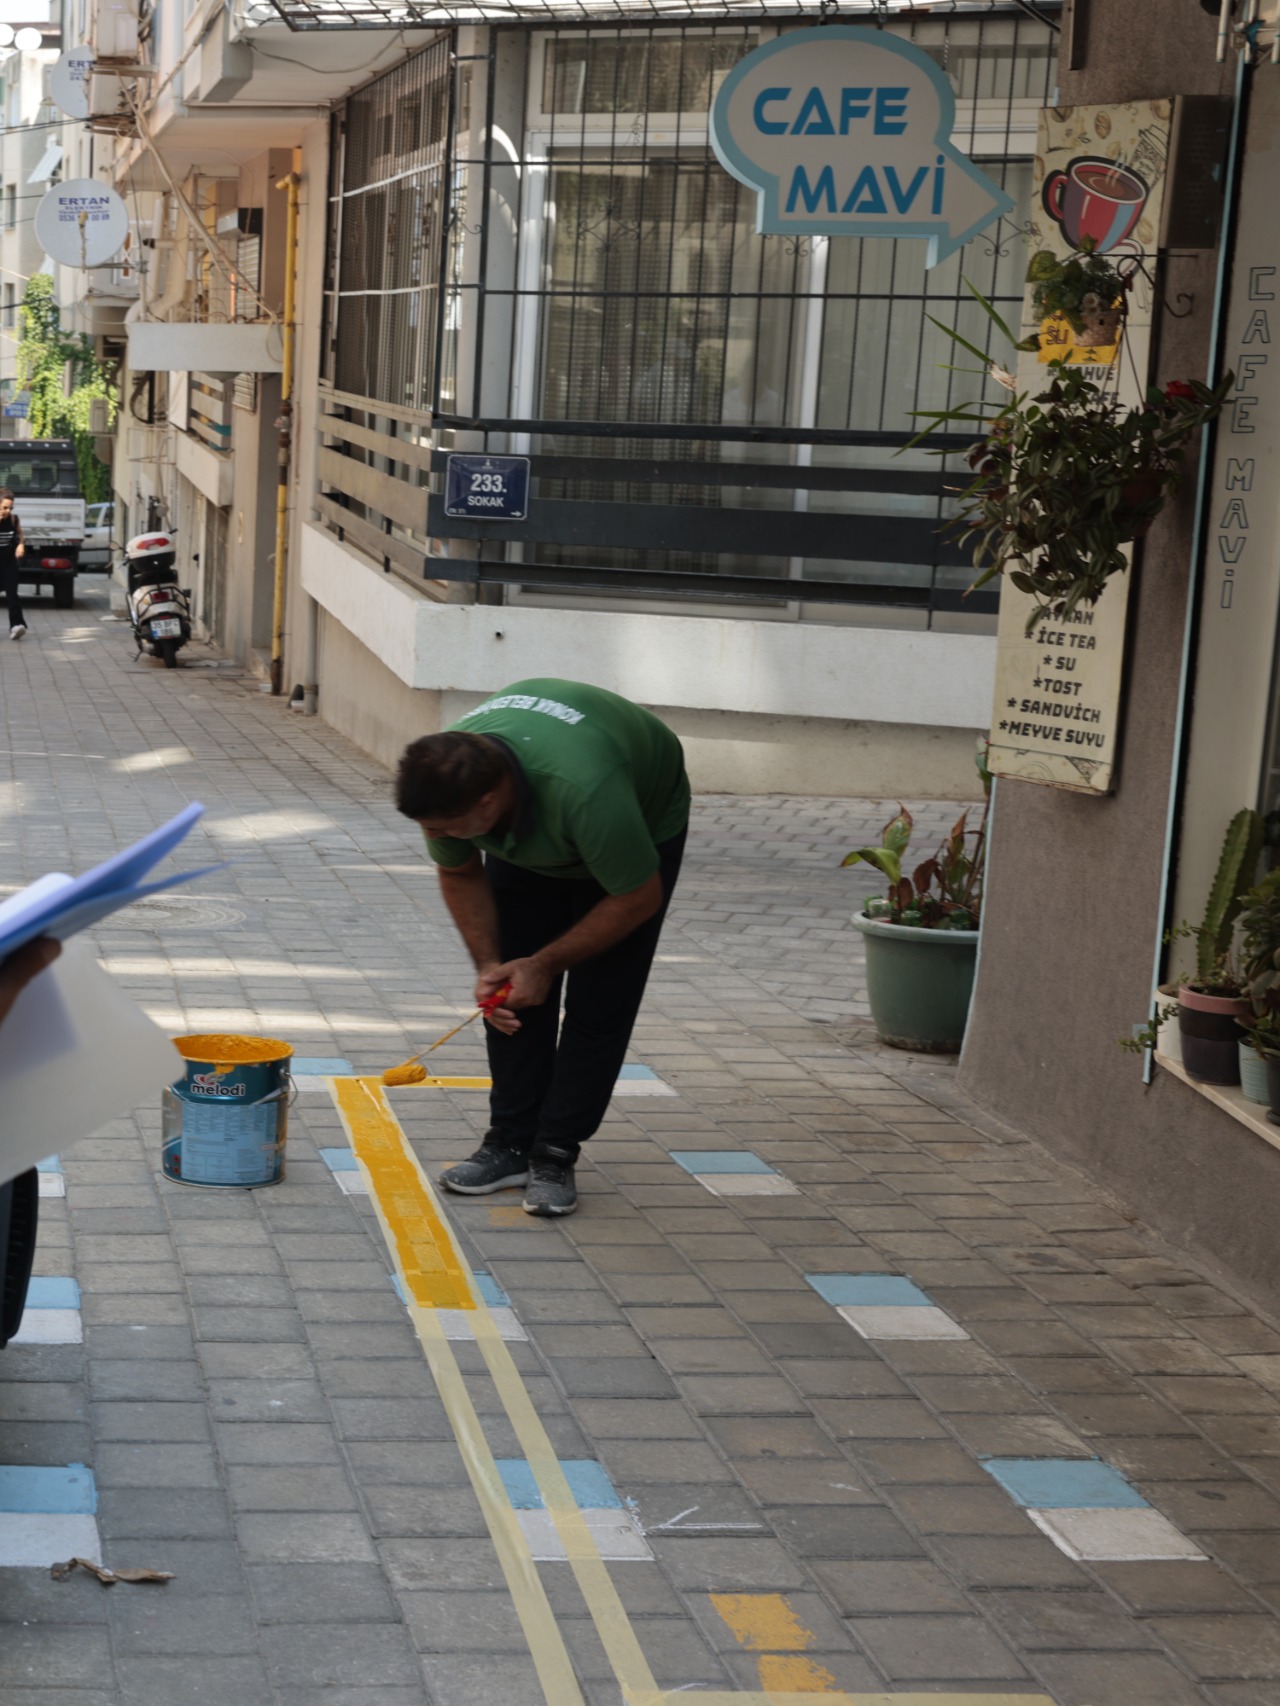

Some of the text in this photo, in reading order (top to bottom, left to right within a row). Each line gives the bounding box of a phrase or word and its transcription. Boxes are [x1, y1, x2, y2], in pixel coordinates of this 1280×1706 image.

[753, 86, 910, 135] CAFE
[785, 154, 945, 215] MAVİ
[59, 197, 110, 205] ERTAN
[1231, 266, 1276, 433] CAFE
[470, 473, 507, 493] 233.
[467, 495, 504, 507] SOKAK
[1037, 626, 1096, 650] İCE TEA
[1055, 656, 1076, 671] SU
[1020, 699, 1101, 723] SANDVİCH
[1065, 728, 1105, 748] SUYU
[191, 1083, 246, 1096] melodi
